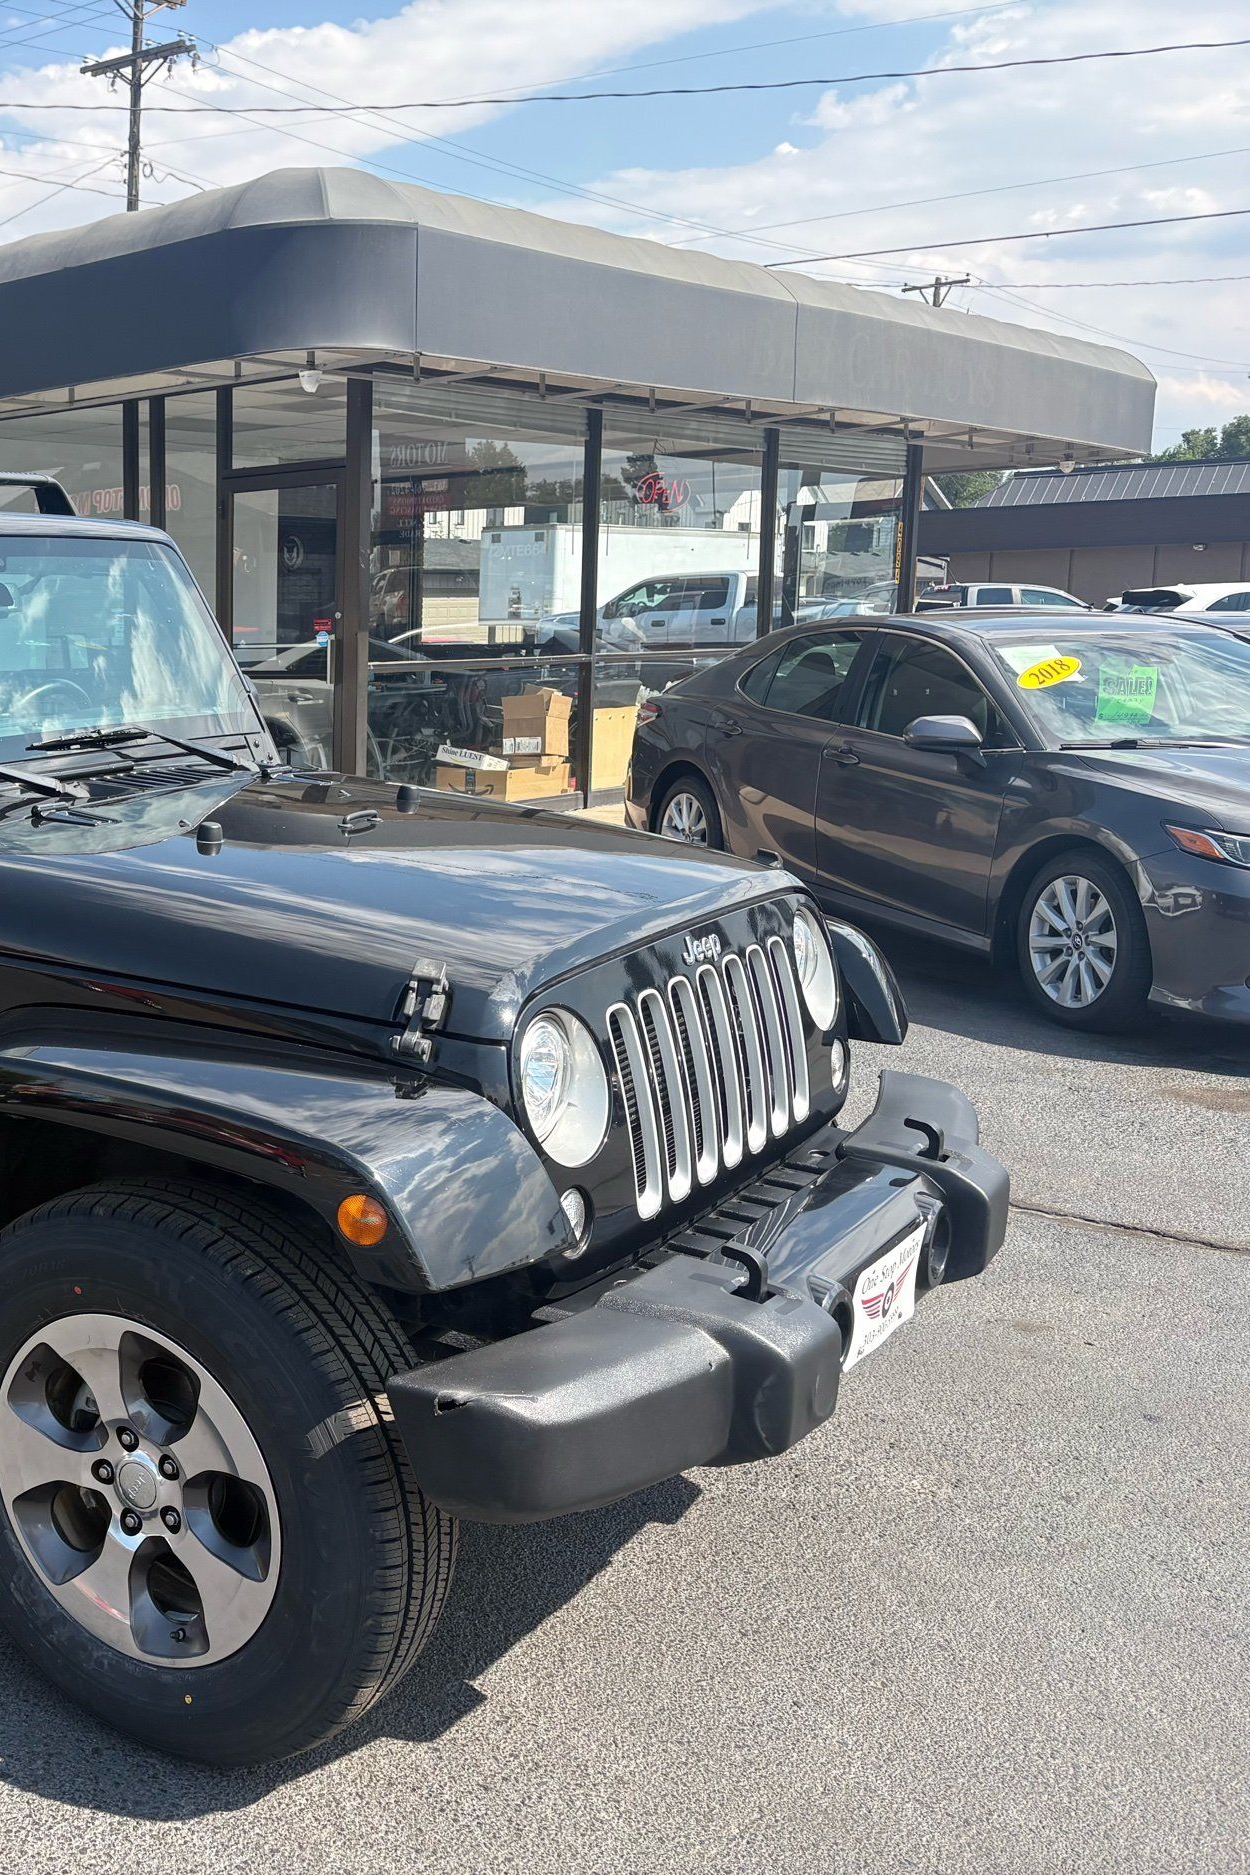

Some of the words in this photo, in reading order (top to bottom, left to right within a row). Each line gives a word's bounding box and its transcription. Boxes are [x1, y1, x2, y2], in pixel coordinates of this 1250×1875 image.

[642, 479, 685, 505] OPEN
[1029, 659, 1071, 685] 2018
[682, 933, 721, 966] Jeep
[127, 1472, 147, 1500] Jeep
